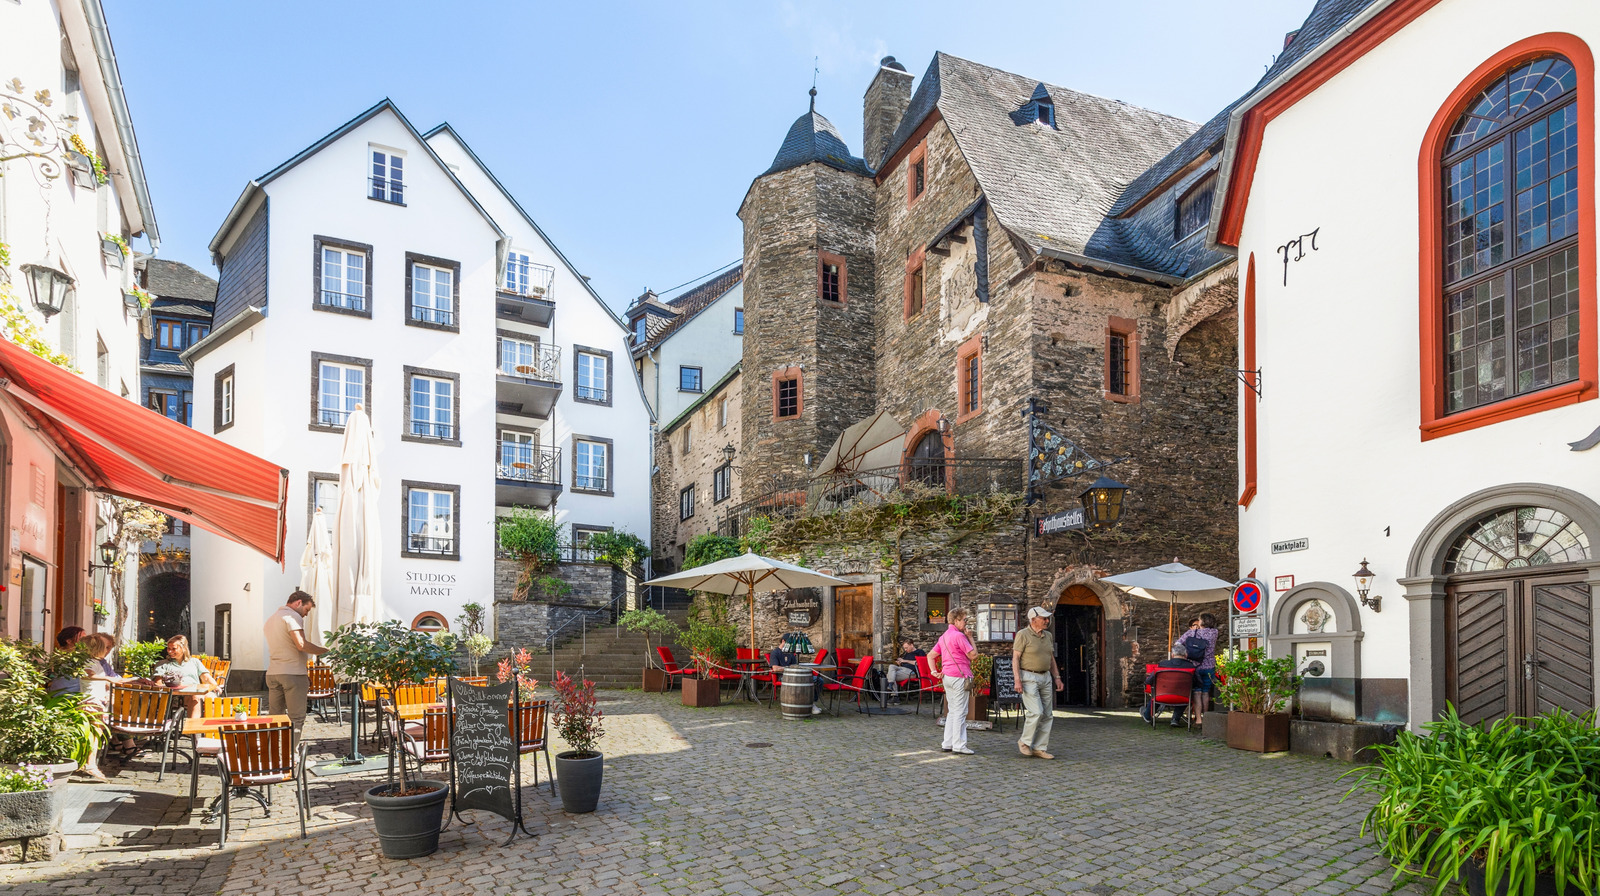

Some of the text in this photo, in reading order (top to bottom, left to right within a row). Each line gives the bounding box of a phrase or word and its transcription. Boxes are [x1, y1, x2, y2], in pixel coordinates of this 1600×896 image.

[1038, 510, 1083, 535] Zehnthauskeller
[1383, 525, 1391, 538] 1
[1273, 540, 1306, 552] Marktplatz
[410, 585, 453, 597] MARKT
